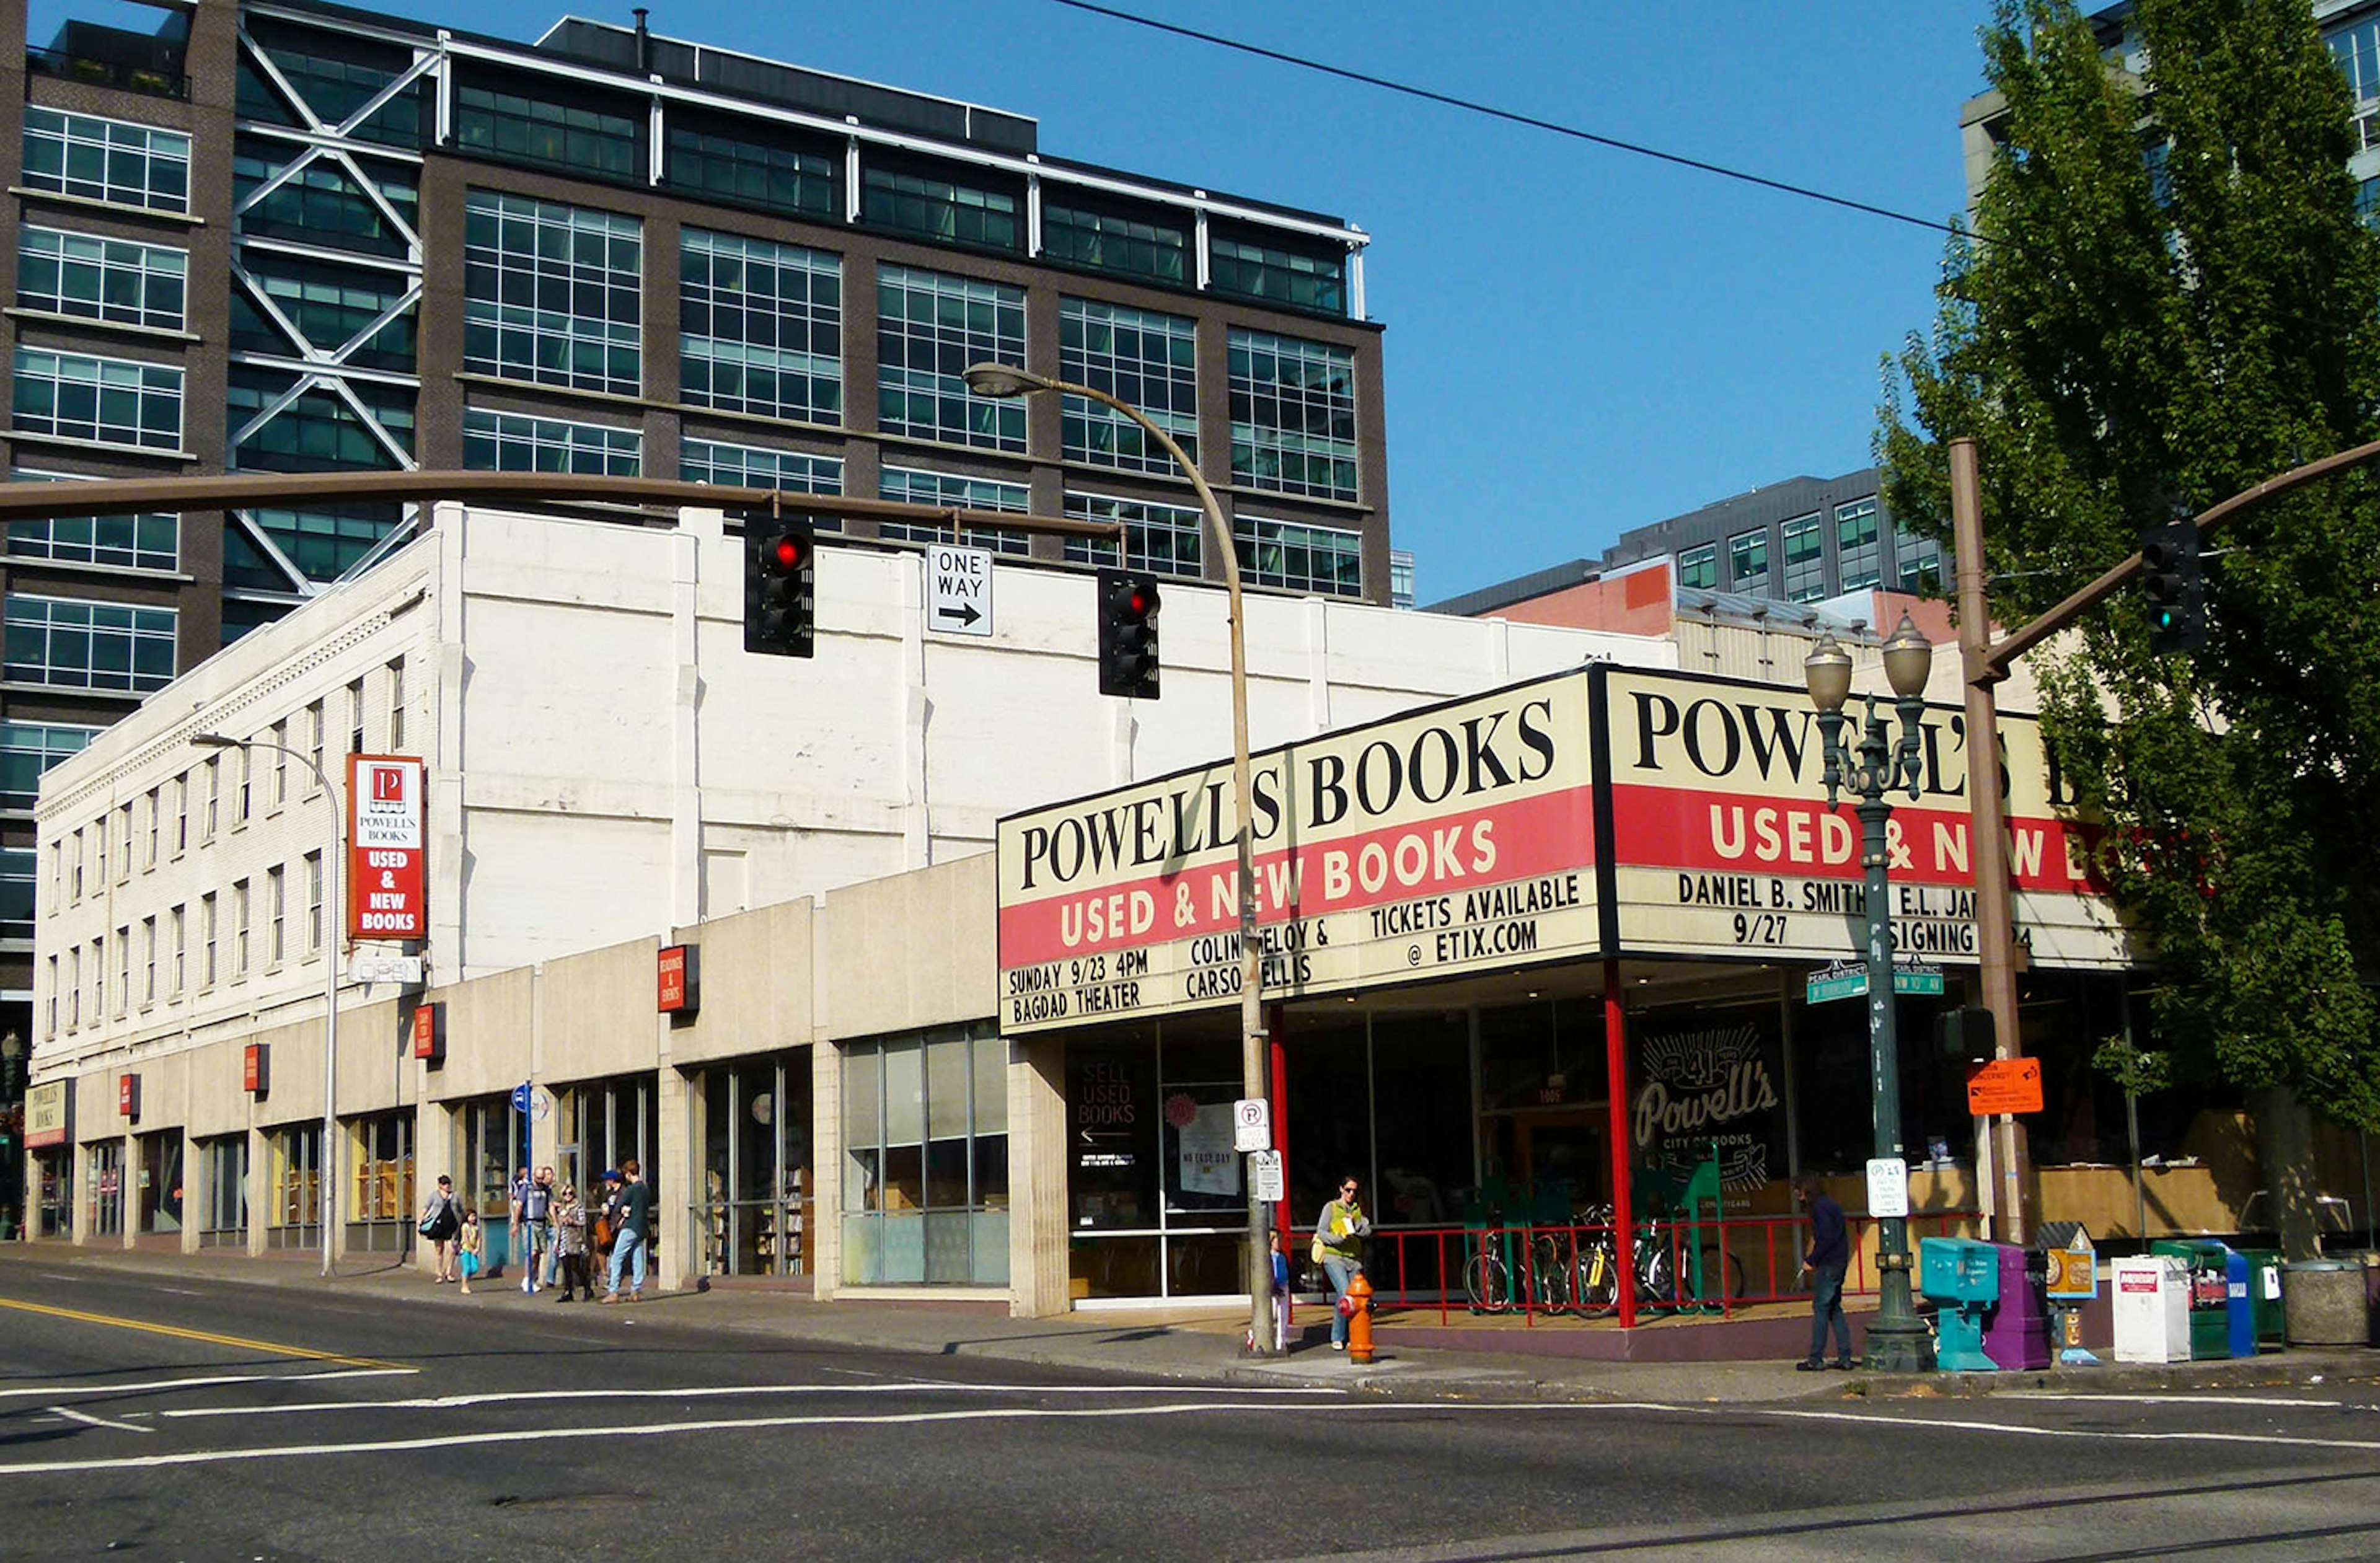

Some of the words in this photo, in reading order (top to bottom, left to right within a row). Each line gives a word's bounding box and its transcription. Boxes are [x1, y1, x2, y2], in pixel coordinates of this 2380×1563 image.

[940, 552, 981, 575] ONE
[938, 575, 983, 598] WAY
[1307, 698, 1555, 829] BOOKS
[368, 830, 408, 842] BOOKS
[1709, 804, 1853, 866] USED
[1885, 819, 1914, 870] &
[1933, 822, 2044, 877] NW
[368, 851, 408, 868] USED
[381, 870, 396, 889] &
[1060, 890, 1155, 948] USED
[1173, 881, 1197, 928] &
[1323, 819, 1497, 901] BOOKS
[1678, 873, 1762, 907] DANIEL
[1771, 879, 1793, 909] B.
[1803, 881, 1866, 912] SMITH
[369, 892, 406, 910] NEW
[1370, 897, 1451, 938] TICKETS
[1464, 874, 1579, 923] AVAILABLE
[1900, 887, 1937, 916] E.L.
[361, 912, 415, 930] BOOKS
[1734, 912, 1787, 944] 9/27
[1191, 933, 1240, 965] COLIN
[1316, 918, 1329, 946] &
[1407, 944, 1422, 966] @
[1436, 920, 1537, 962] ETIX.COM
[1889, 922, 1973, 952] SIGNING
[1009, 963, 1062, 995] SUNDAY
[1071, 956, 1106, 984] 9/23
[1116, 948, 1148, 977] 4PM
[1261, 954, 1311, 987] ELLIS
[1013, 993, 1067, 1023] BAGDAD
[1076, 982, 1140, 1013] THEATER
[1083, 1062, 1130, 1083] SELL
[1083, 1084, 1131, 1104] USED
[1634, 1060, 1779, 1147] Powell's
[1078, 1103, 1135, 1125] BOOKS
[1663, 1137, 1689, 1150] CITY
